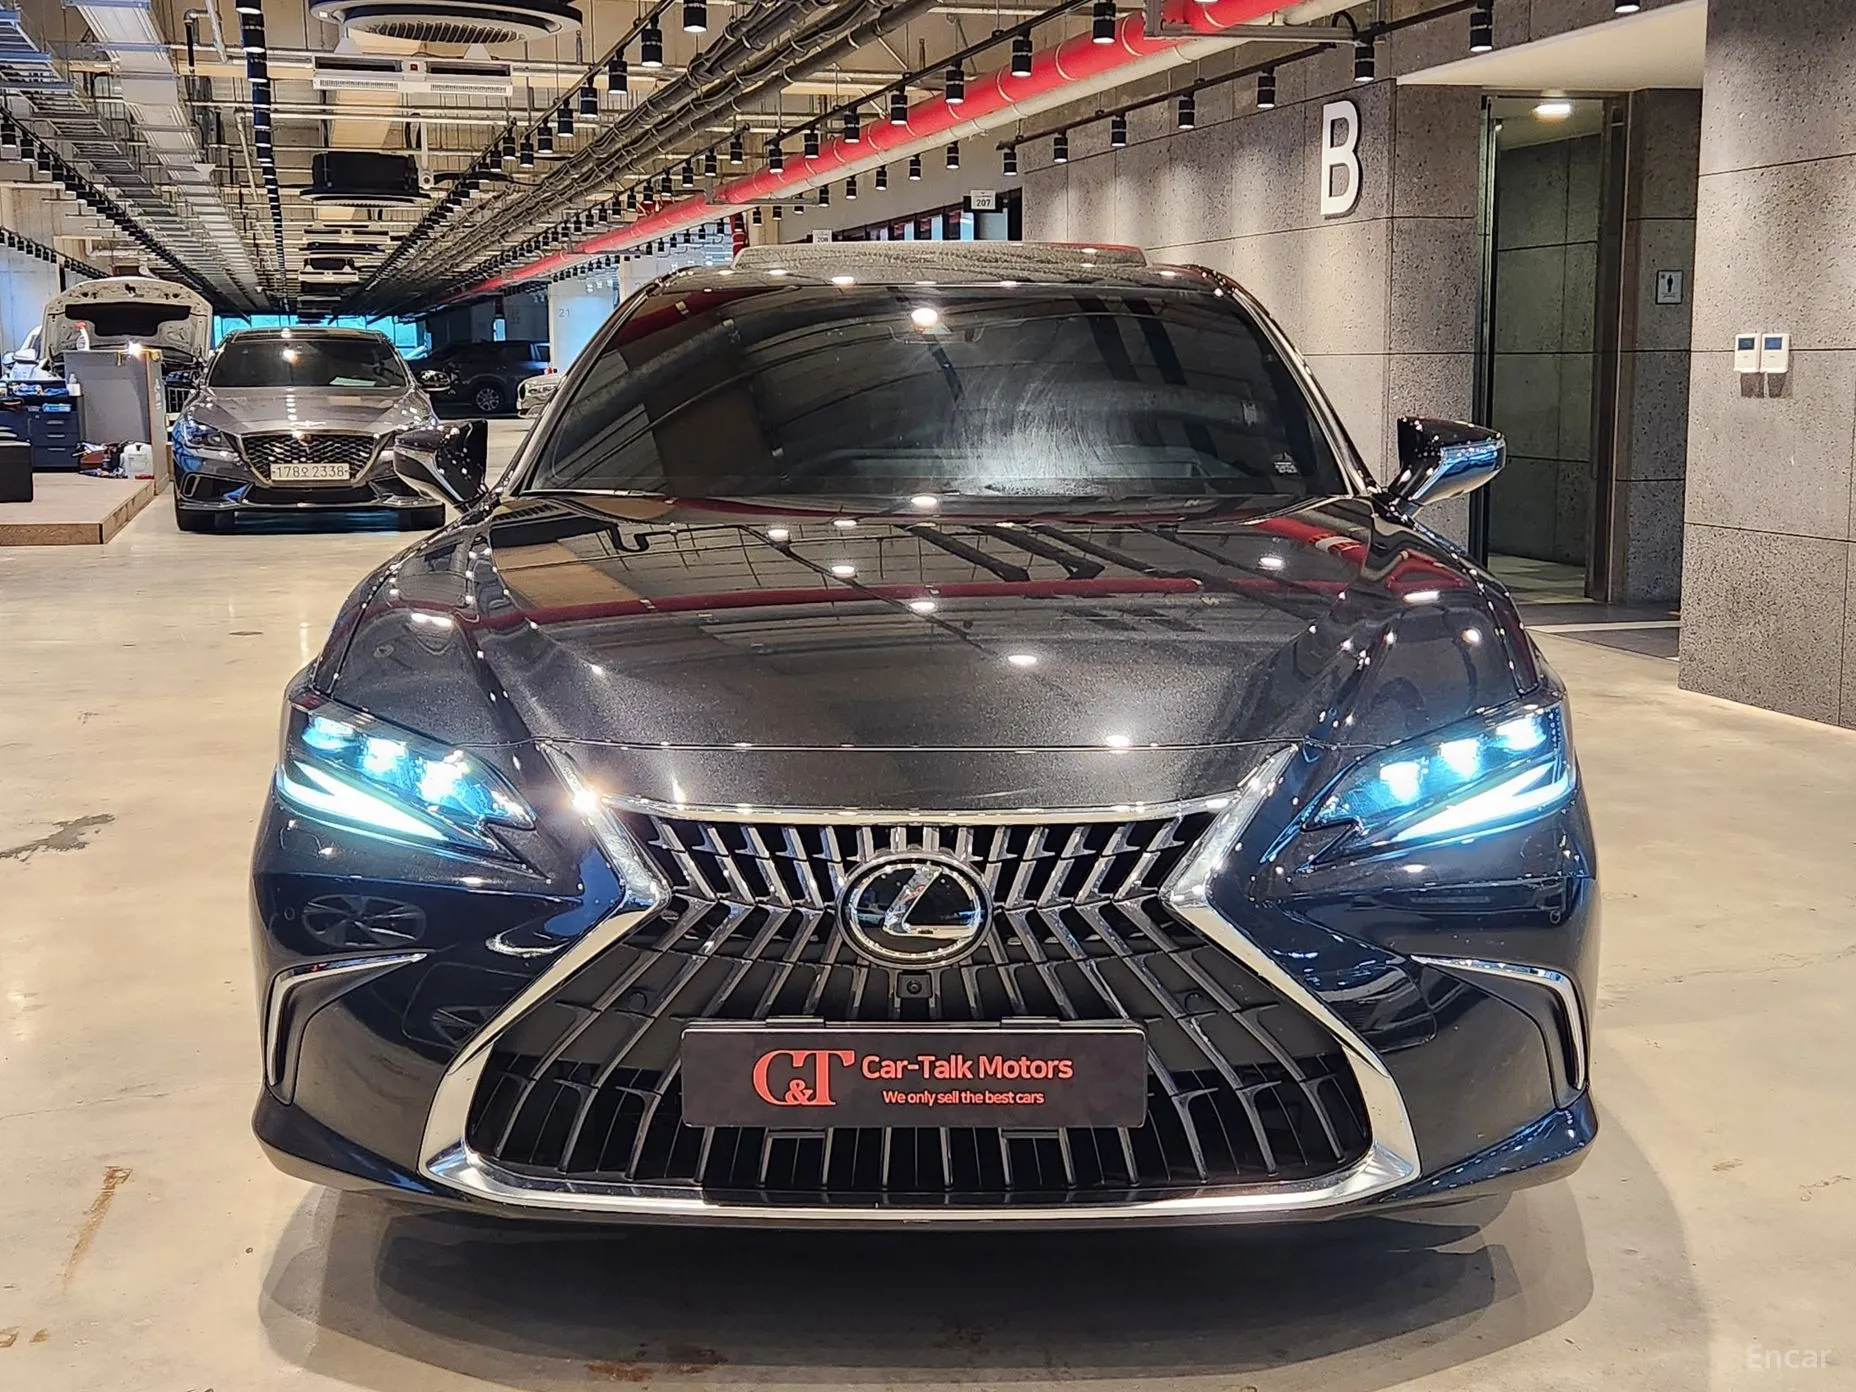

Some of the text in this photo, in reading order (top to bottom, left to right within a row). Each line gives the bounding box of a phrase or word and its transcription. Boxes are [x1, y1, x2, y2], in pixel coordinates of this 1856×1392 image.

[1320, 100, 1360, 216] B
[976, 198, 991, 207] 207
[558, 308, 570, 318] 21
[861, 1054, 1074, 1080] Car-Talk Motors
[883, 1090, 1045, 1107] We only sell the best cars
